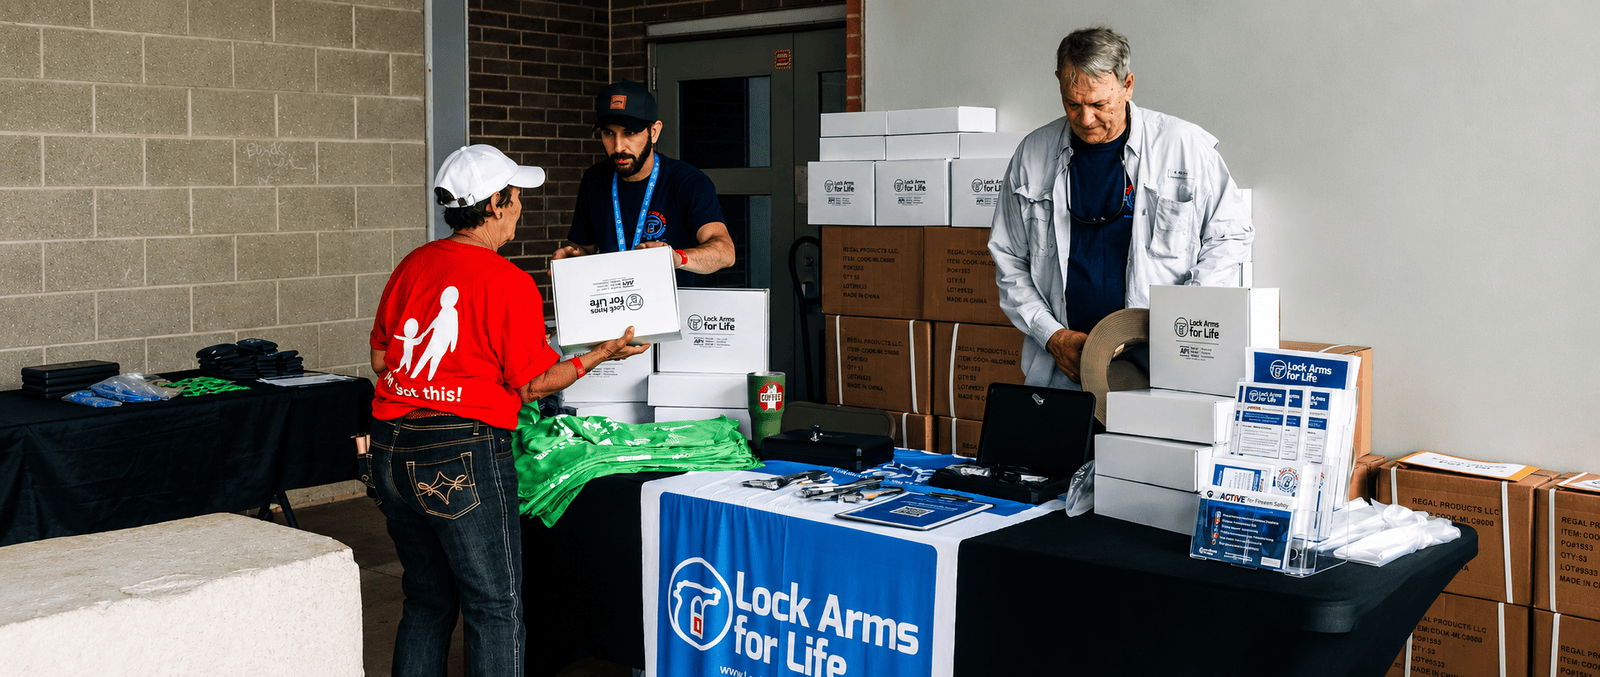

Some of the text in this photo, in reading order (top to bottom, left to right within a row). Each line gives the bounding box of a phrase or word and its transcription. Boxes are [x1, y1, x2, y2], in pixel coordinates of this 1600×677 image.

[590, 296, 624, 308] for Life
[704, 322, 735, 330] for Life
[1190, 327, 1219, 339] for Life
[1288, 362, 1332, 375] Lock Arms
[1287, 372, 1318, 382] for Life
[423, 386, 462, 402] this!
[1220, 493, 1246, 503] ACTIVE
[1412, 497, 1438, 507] REGAL
[1440, 501, 1483, 514] PRODUCTS
[1562, 516, 1587, 527] REGAL
[1561, 528, 1581, 538] ITEM:
[1560, 575, 1581, 585] MADE
[736, 570, 919, 655] Lock Arms
[1434, 618, 1472, 630] PRODUCTS
[1473, 625, 1487, 633] LLC
[734, 614, 847, 677] for Life
[1561, 645, 1585, 656] REGAL
[1560, 656, 1580, 666] ITEM:
